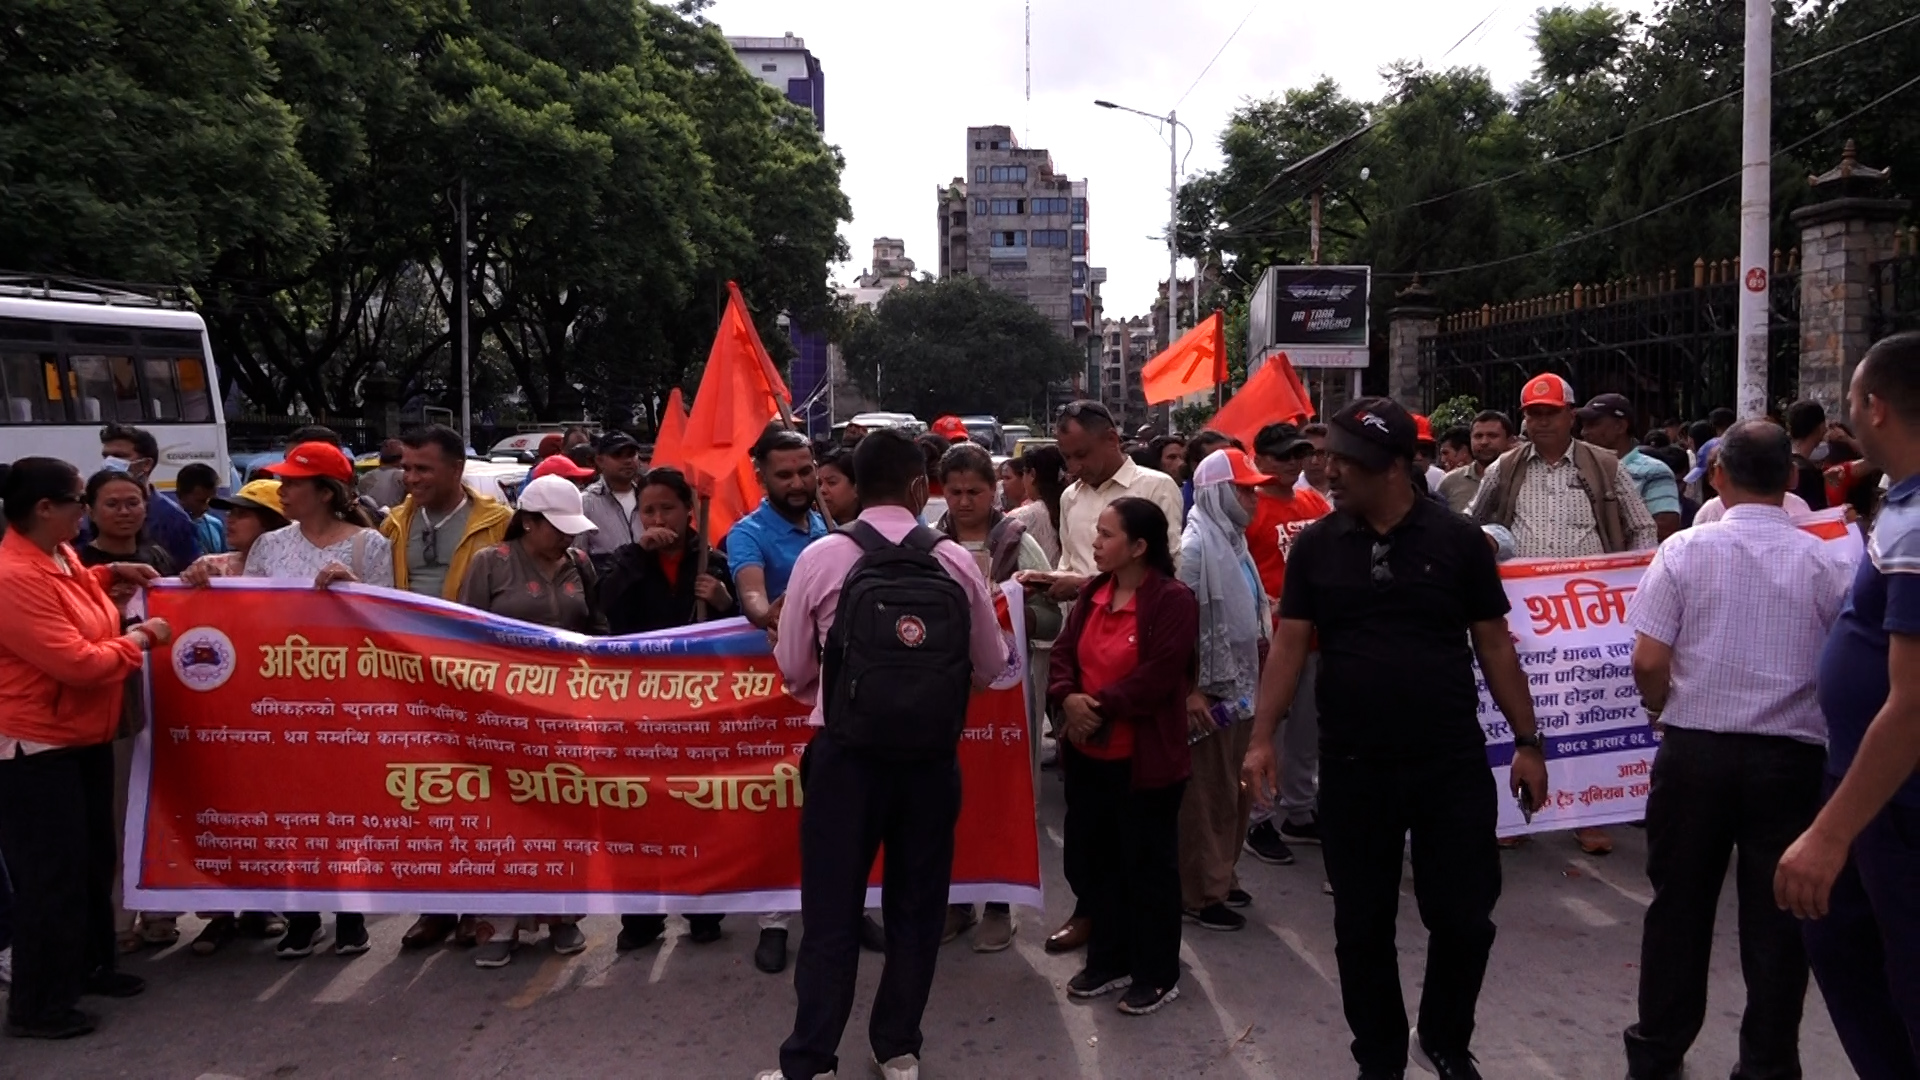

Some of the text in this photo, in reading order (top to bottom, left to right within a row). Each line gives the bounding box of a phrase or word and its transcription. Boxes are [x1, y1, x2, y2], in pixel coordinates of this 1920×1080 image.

[1523, 578, 1637, 636] श्रमि
[259, 634, 776, 708] अखिल नेपाल पसल तथा सेल्स मजदुर संघ
[1575, 705, 1640, 725] अधिकार
[521, 743, 550, 758] तथा
[1616, 759, 1650, 778] आयो
[506, 762, 651, 809] श्रमिक
[460, 815, 480, 830] गर
[305, 837, 330, 850] तथा
[668, 844, 688, 858] गर
[545, 861, 565, 877] गर
